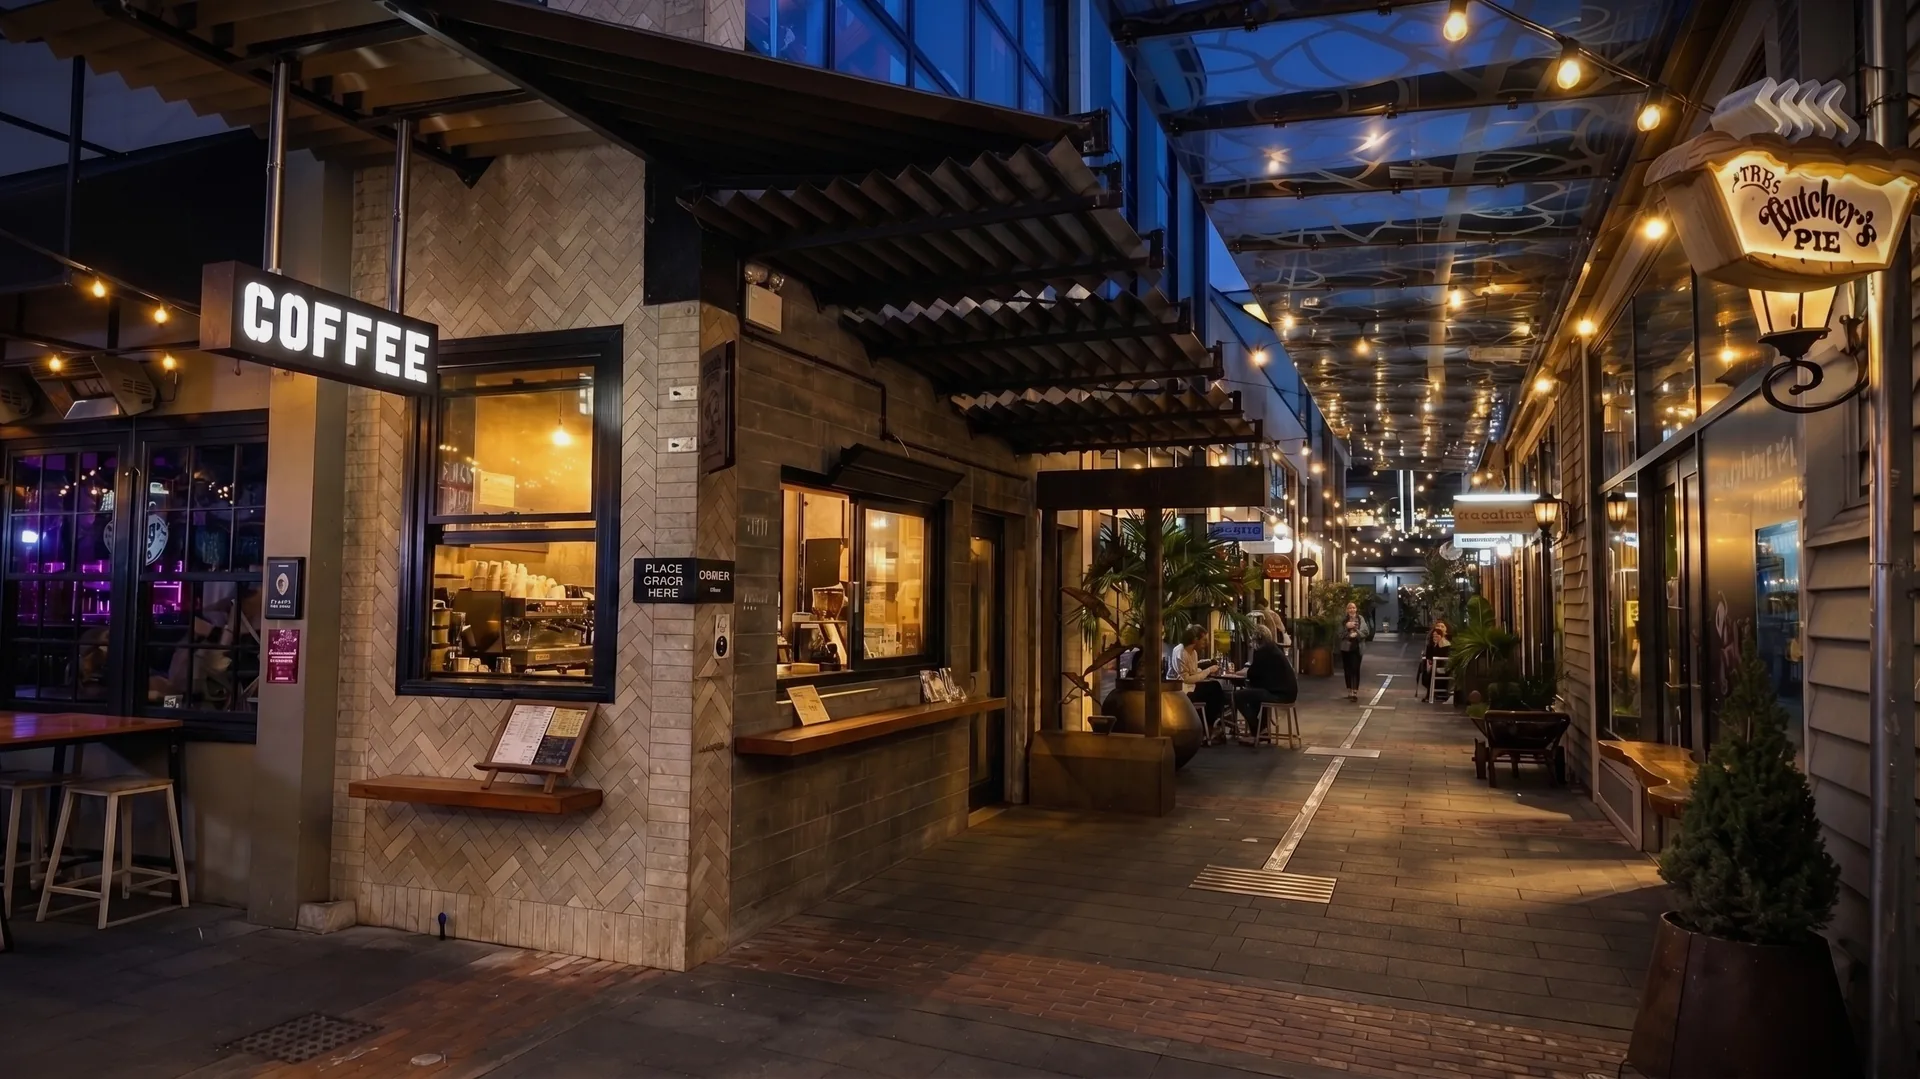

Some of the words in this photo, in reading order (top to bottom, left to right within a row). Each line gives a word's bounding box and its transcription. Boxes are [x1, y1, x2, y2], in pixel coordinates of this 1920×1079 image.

[1758, 178, 1877, 247] Butcher's
[1794, 228, 1841, 254] PIE
[242, 281, 430, 384] COFFEE
[645, 563, 683, 574] PLACE
[648, 588, 679, 598] HERE
